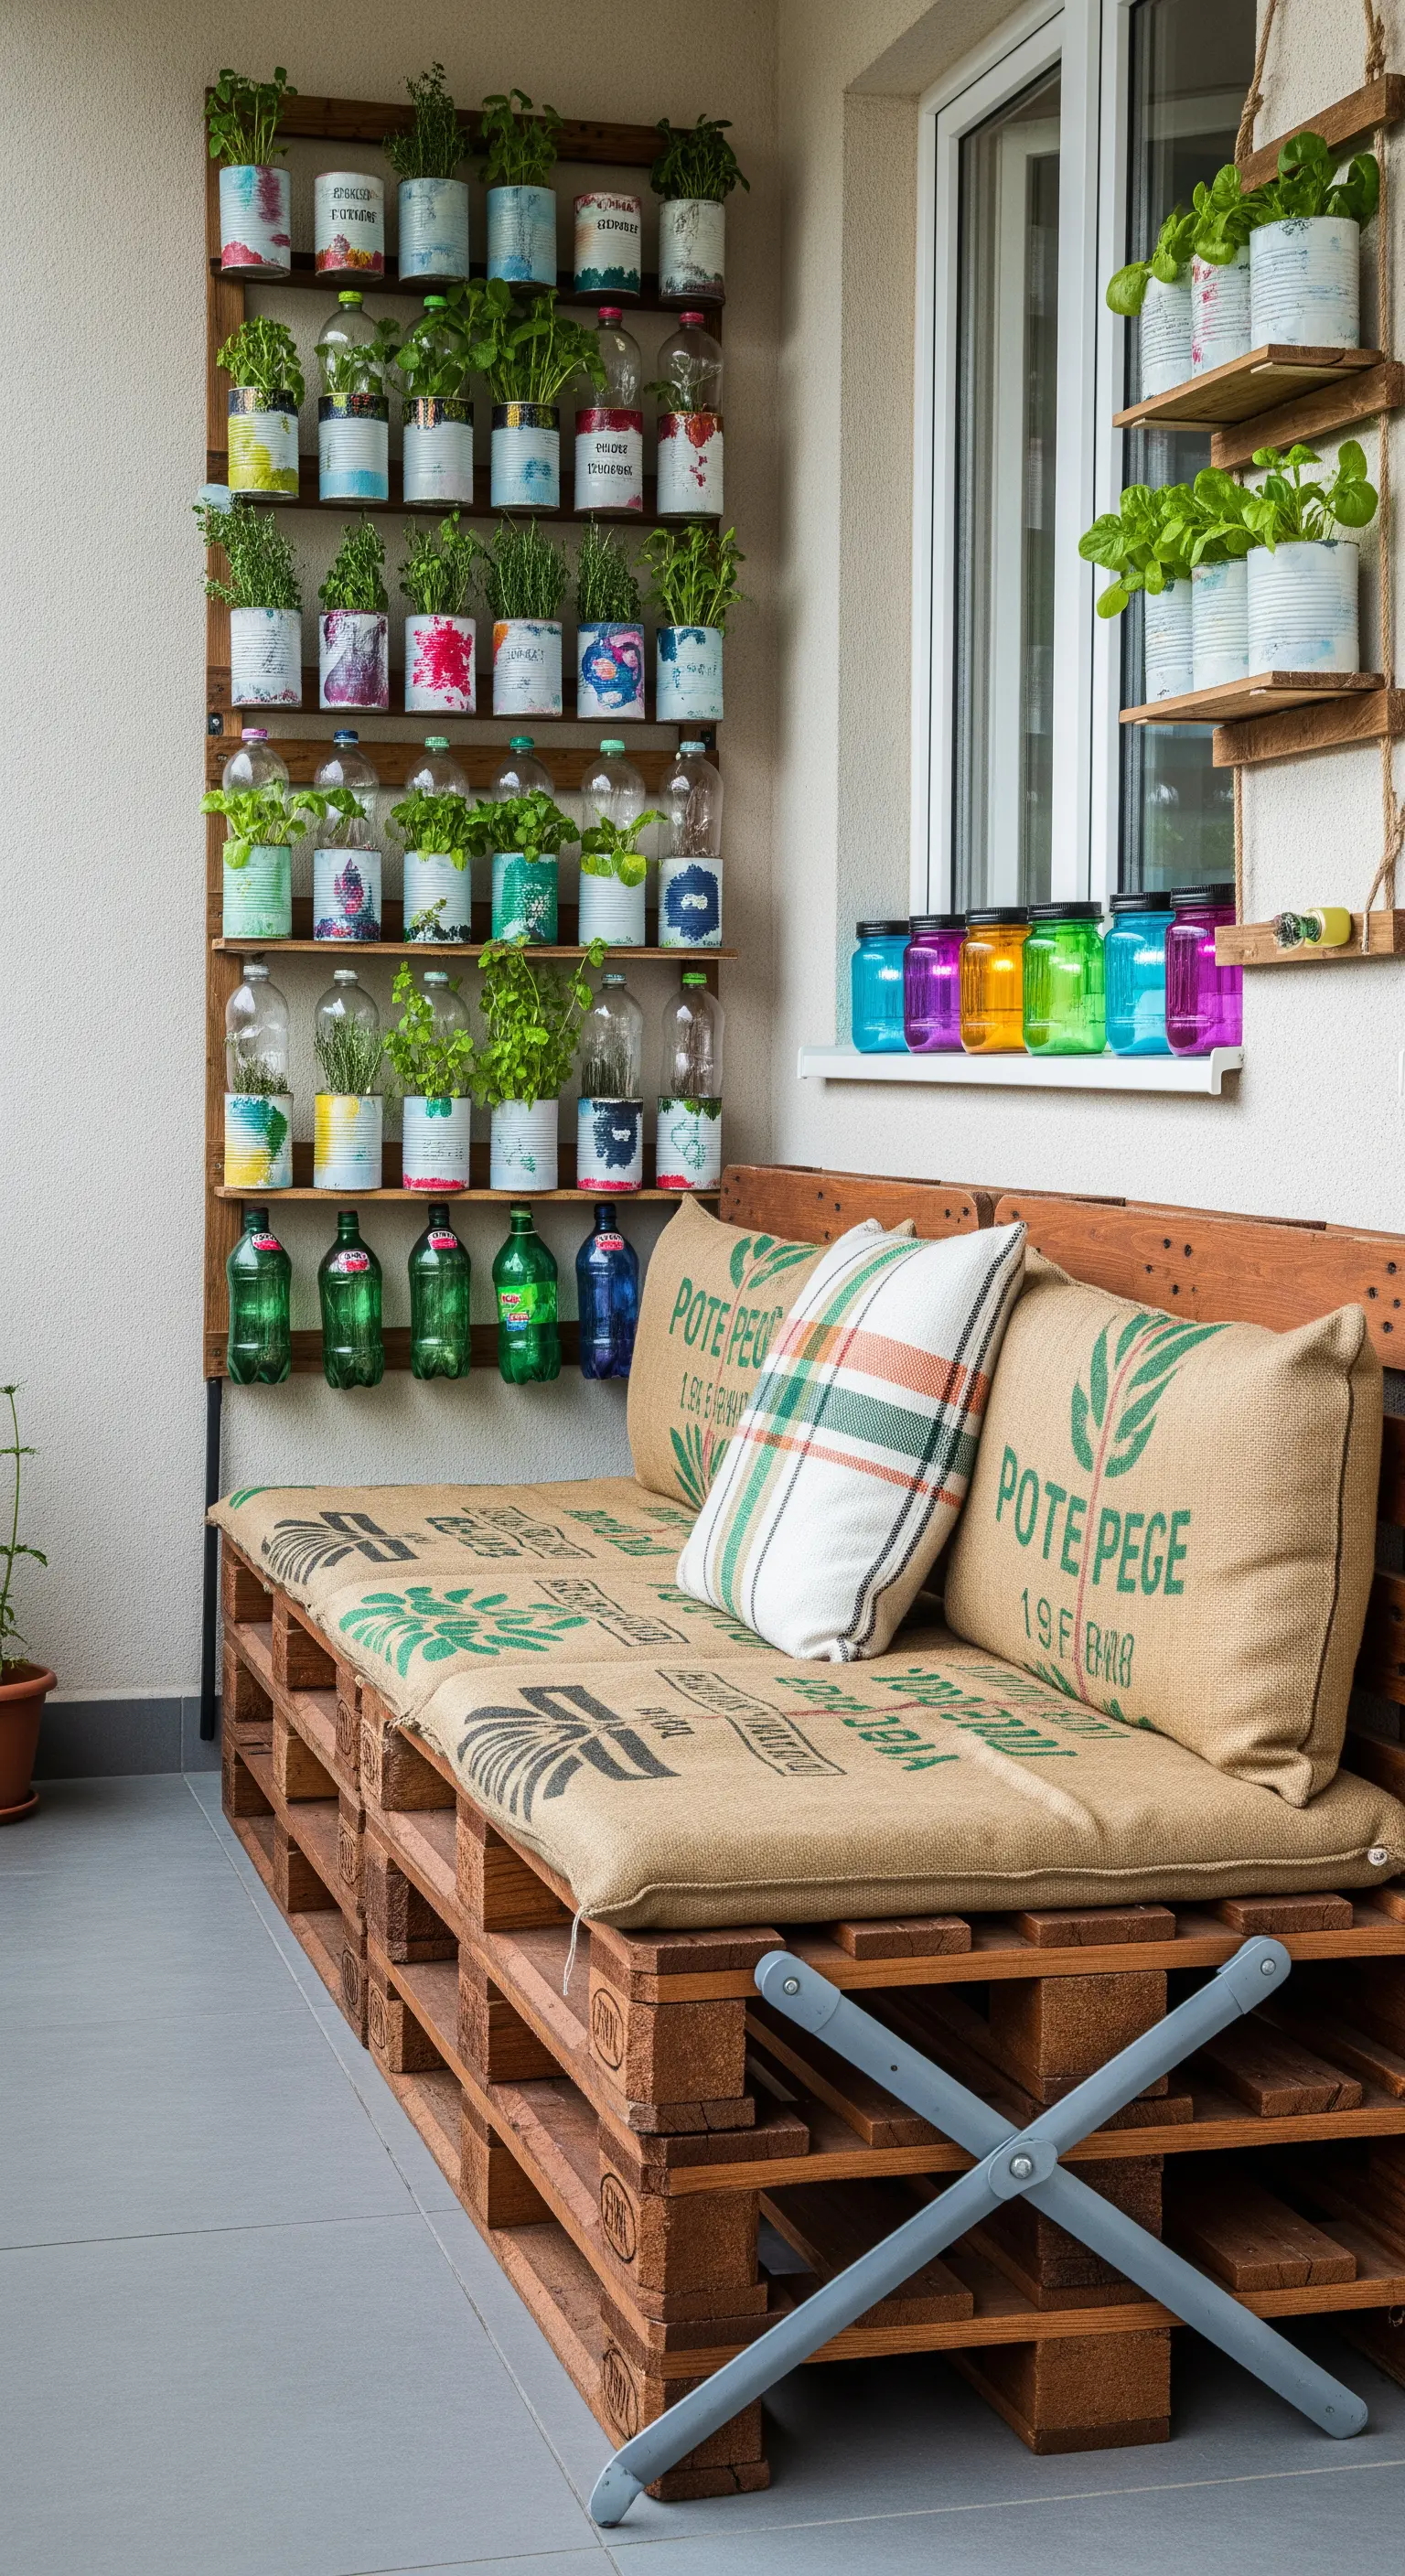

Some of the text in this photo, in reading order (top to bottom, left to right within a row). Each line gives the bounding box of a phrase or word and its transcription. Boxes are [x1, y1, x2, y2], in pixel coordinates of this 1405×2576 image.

[669, 1277, 731, 1358] POTE
[995, 1444, 1191, 1595] POTE PEGE
